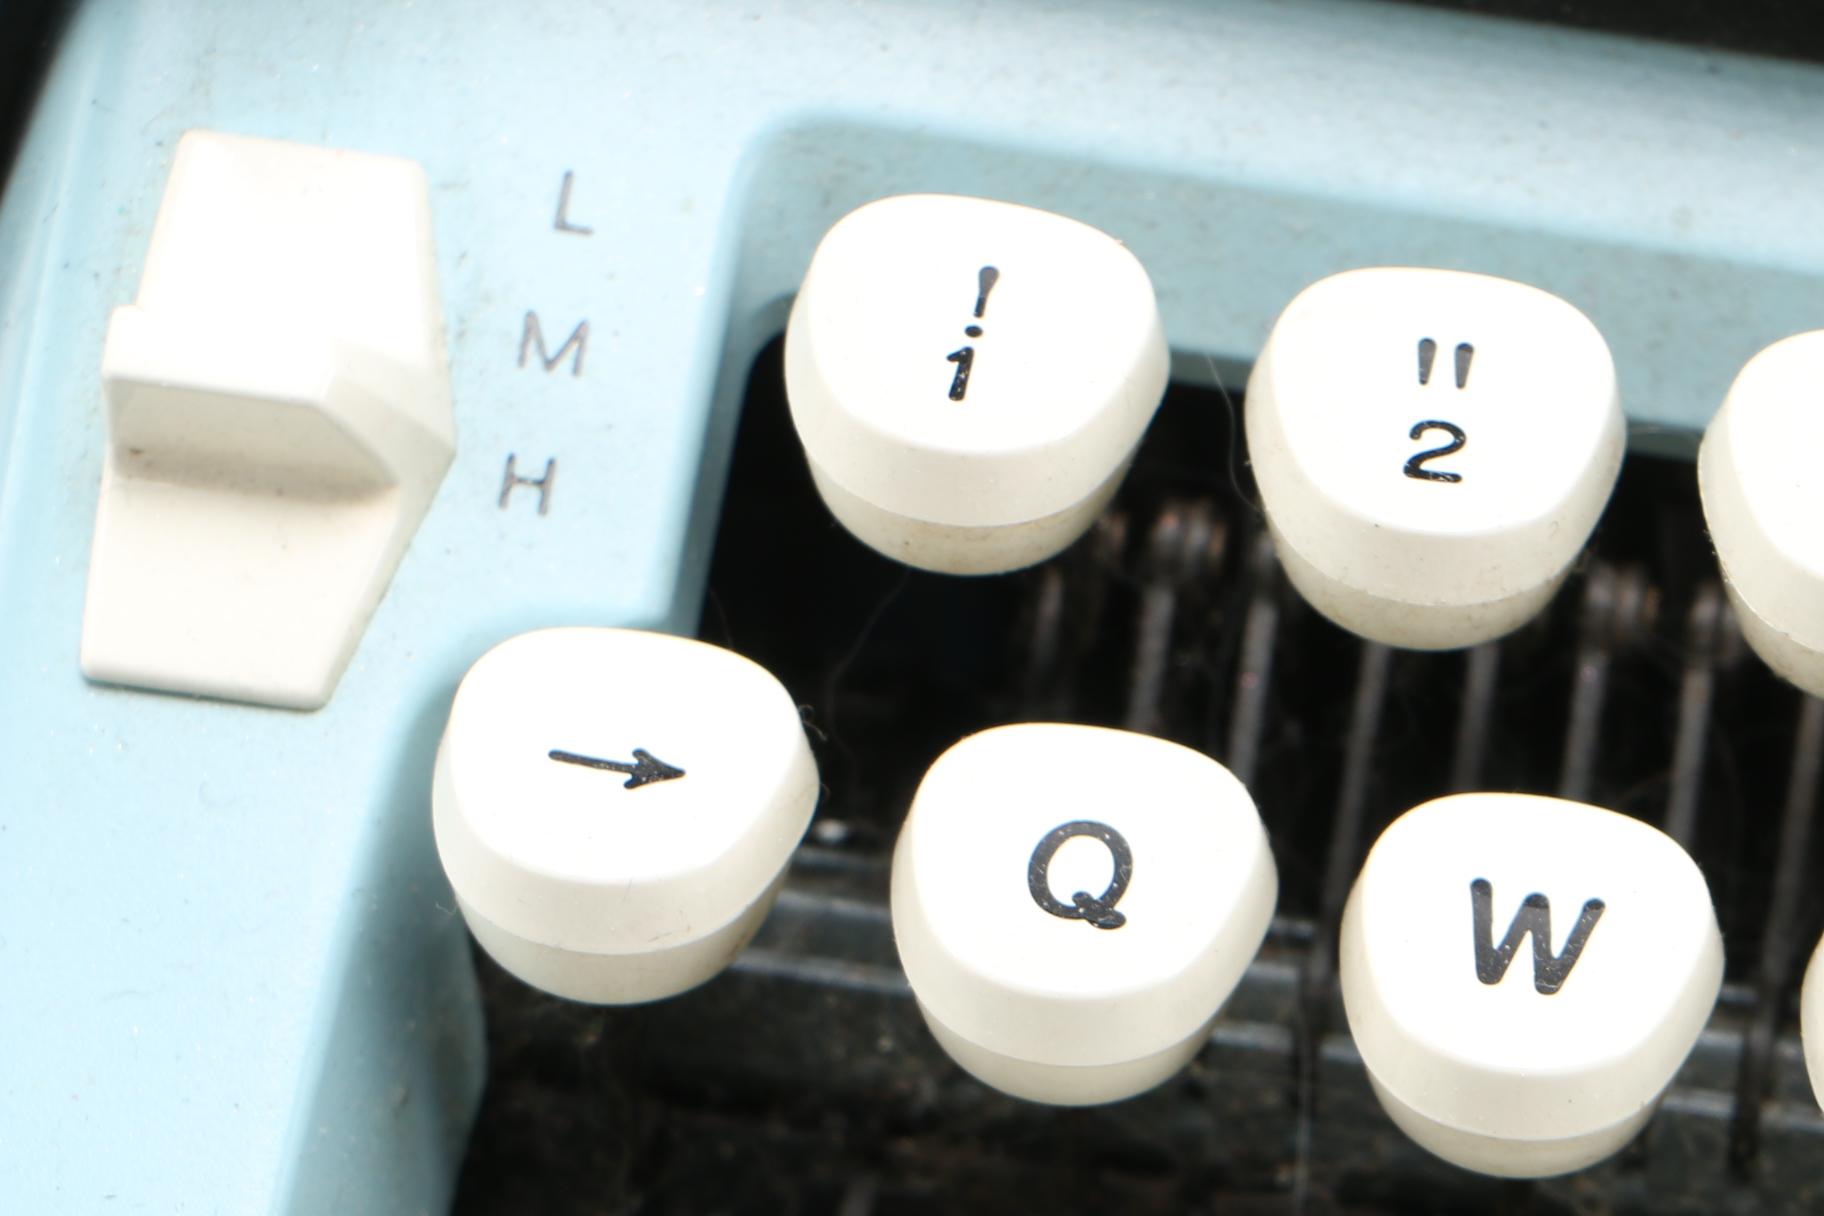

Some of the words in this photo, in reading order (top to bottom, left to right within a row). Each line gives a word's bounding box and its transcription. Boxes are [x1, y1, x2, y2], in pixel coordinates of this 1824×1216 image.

[554, 171, 591, 234] L
[965, 267, 997, 337] !
[519, 312, 585, 374] M
[947, 347, 973, 401] 1
[1404, 421, 1465, 483] 2
[499, 454, 558, 516] H
[1028, 822, 1131, 929] Q
[1471, 879, 1605, 995] W
